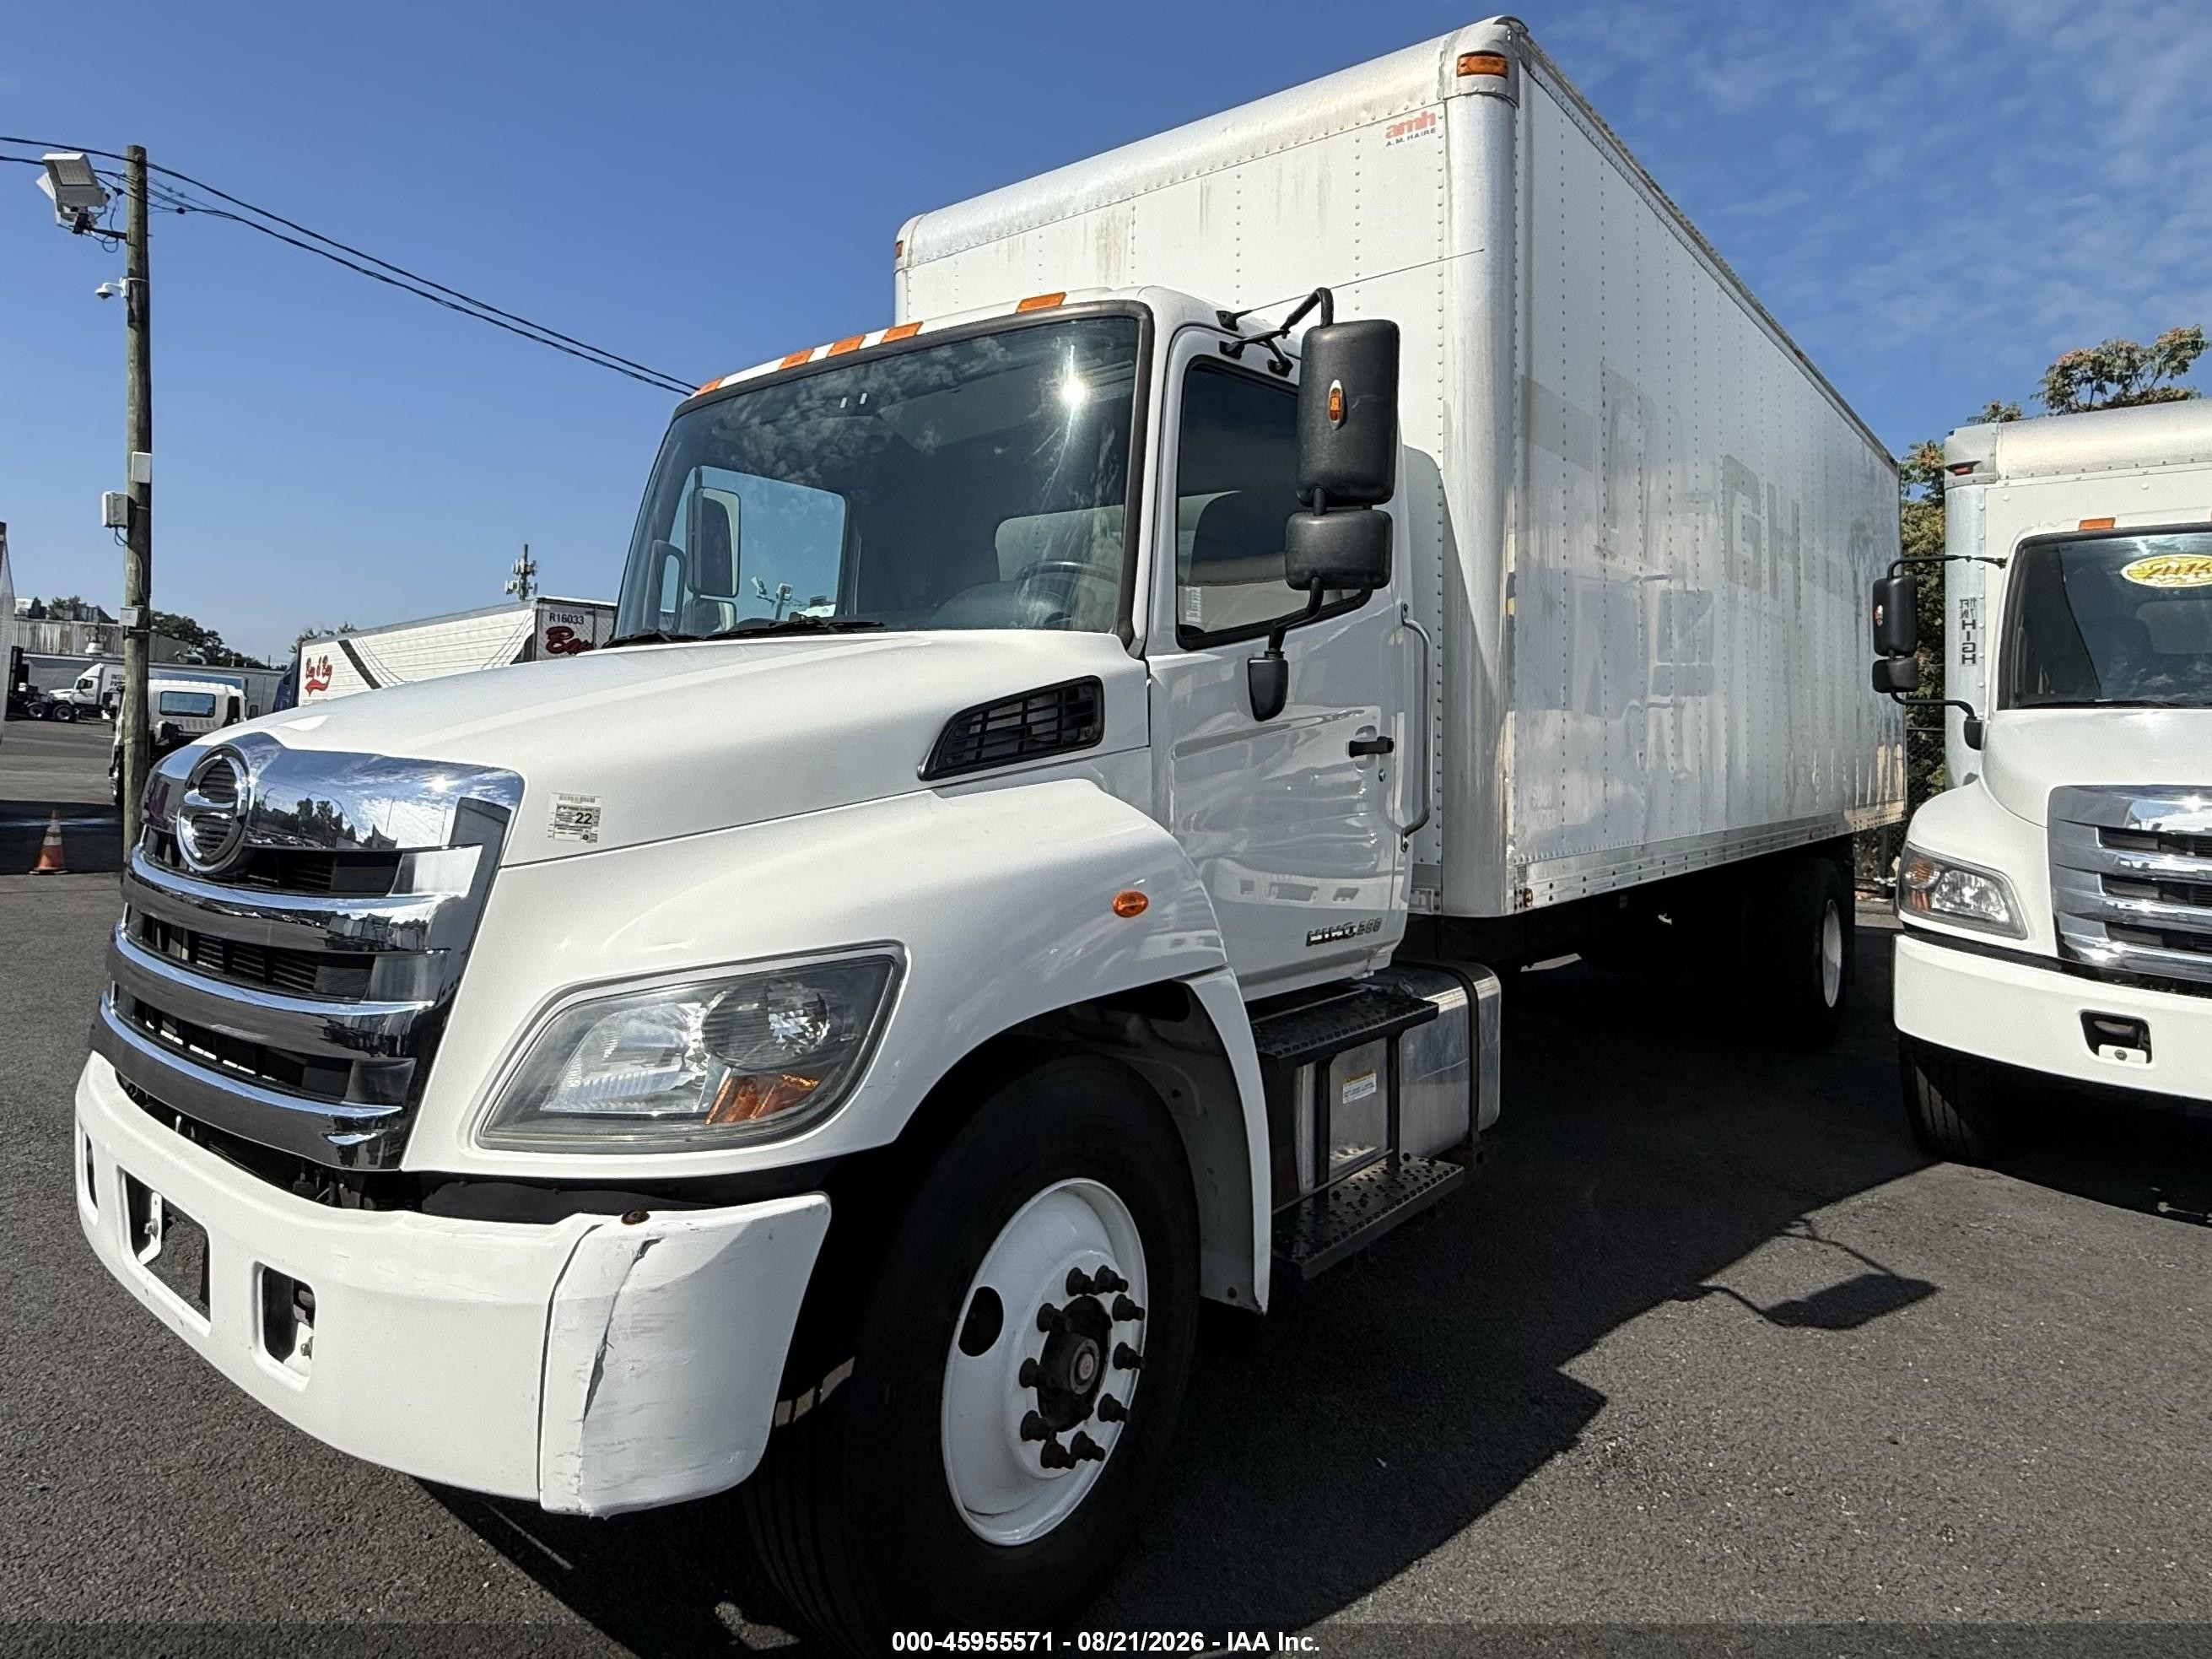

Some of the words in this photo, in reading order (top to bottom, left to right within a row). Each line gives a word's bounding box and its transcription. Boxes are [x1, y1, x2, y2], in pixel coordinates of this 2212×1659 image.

[1385, 111, 1436, 138] amh
[549, 613, 585, 624] R16033
[575, 812, 592, 824] 22
